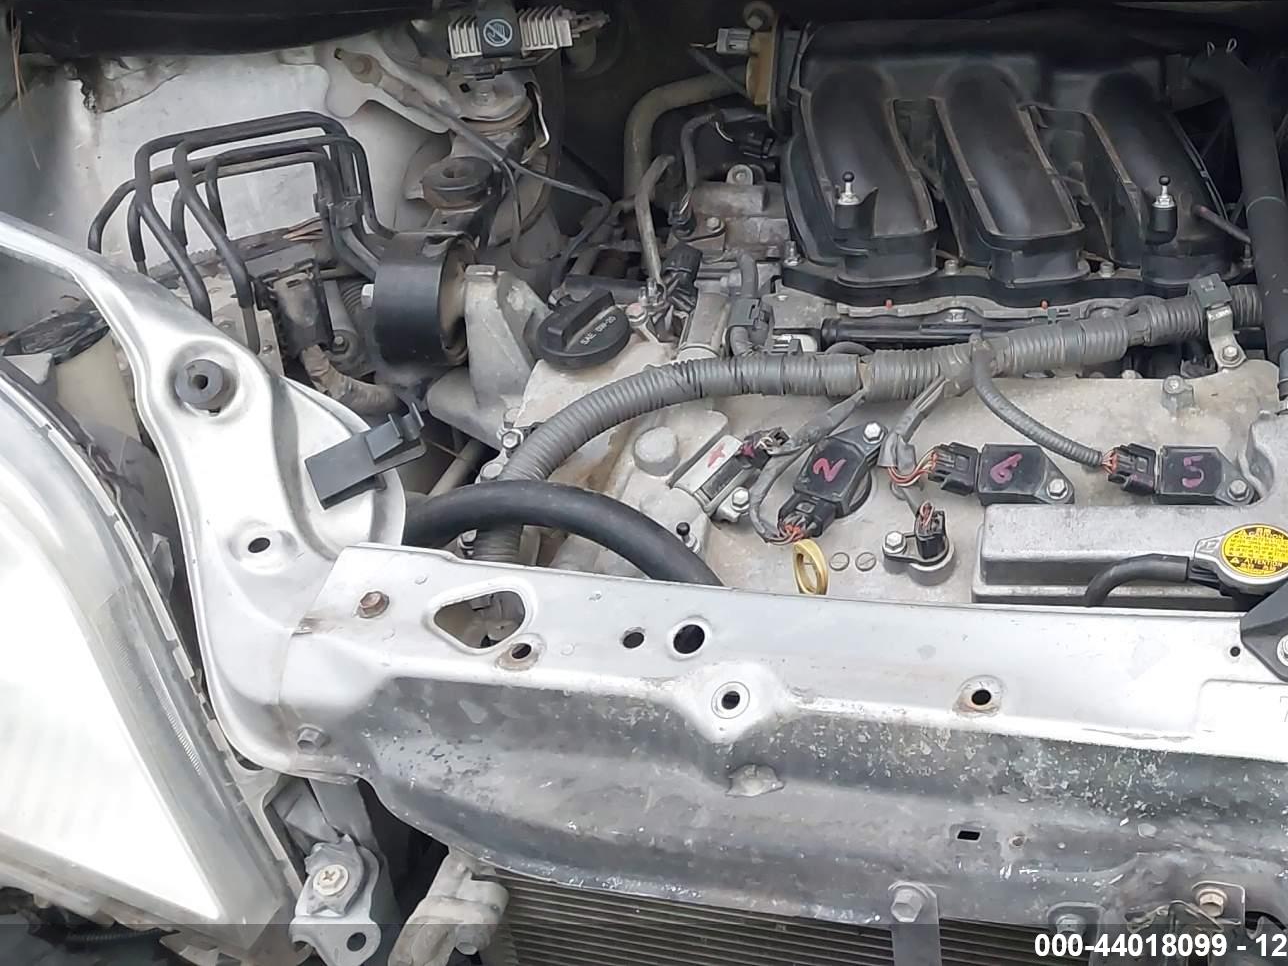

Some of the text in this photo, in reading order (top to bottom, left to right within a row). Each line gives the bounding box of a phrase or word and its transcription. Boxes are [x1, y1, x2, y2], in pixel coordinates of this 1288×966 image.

[580, 332, 597, 345] SAE
[812, 457, 847, 482] 2
[989, 451, 1024, 484] 6
[1181, 455, 1206, 489] 5
[1248, 531, 1284, 541] CAUTION
[1243, 557, 1283, 568] ATTENTION
